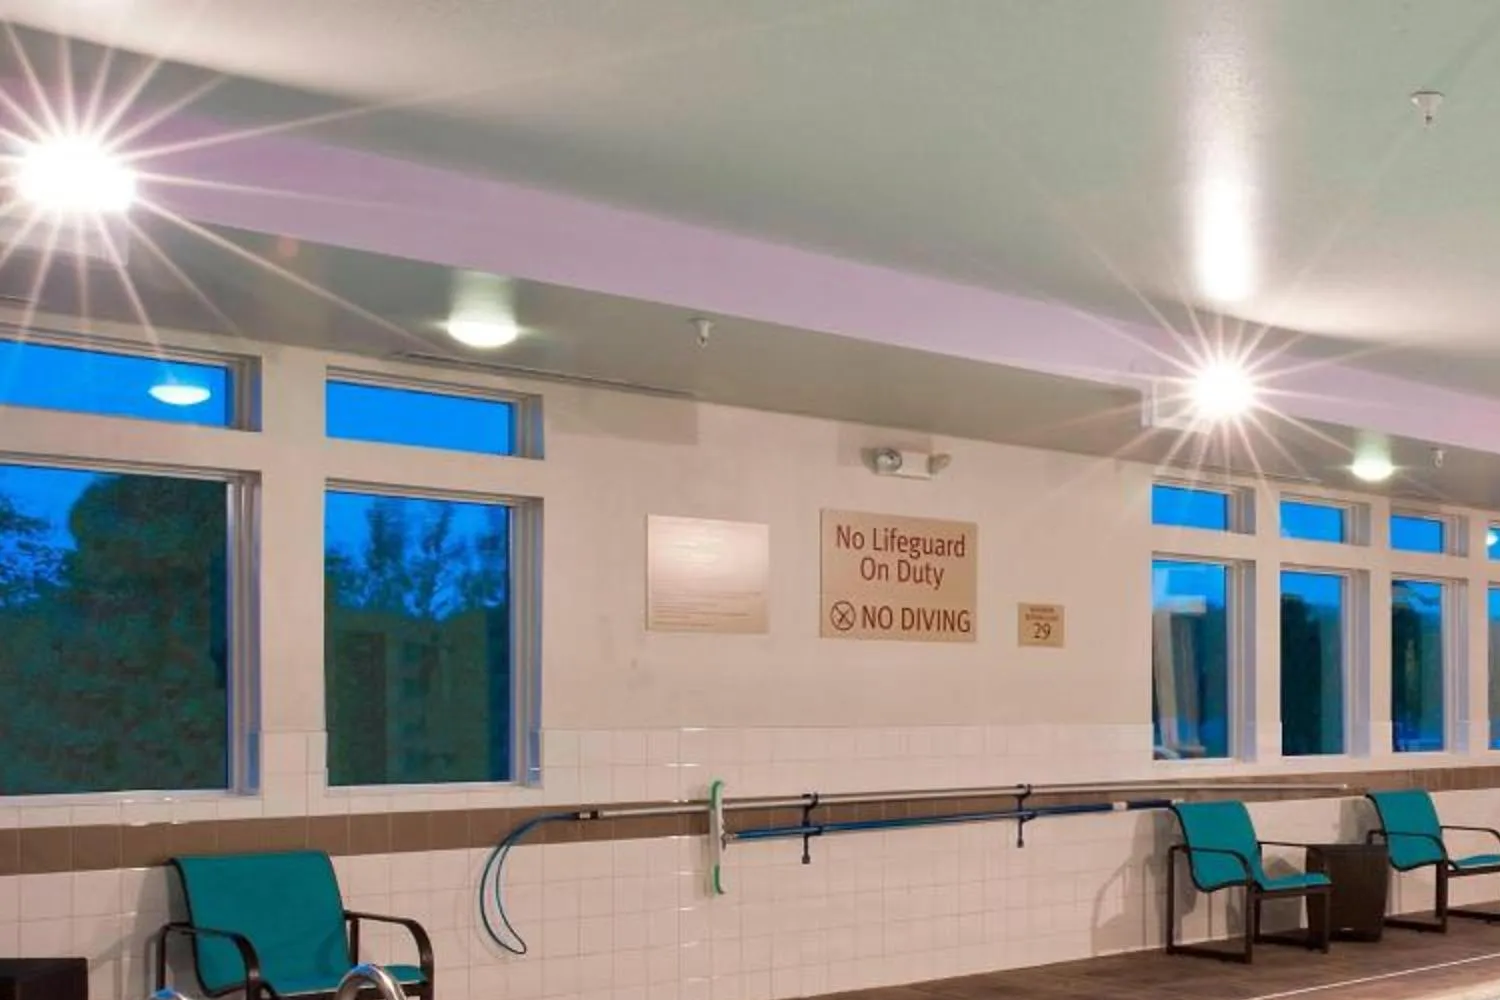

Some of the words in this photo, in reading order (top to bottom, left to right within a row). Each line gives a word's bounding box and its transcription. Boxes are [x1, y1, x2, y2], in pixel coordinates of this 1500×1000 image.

[836, 524, 865, 550] No
[873, 527, 966, 560] Lifeguard
[860, 557, 889, 581] On
[897, 559, 945, 590] Duty
[862, 604, 893, 630] NO
[901, 607, 971, 633] DIVING
[1033, 622, 1051, 640] 29
